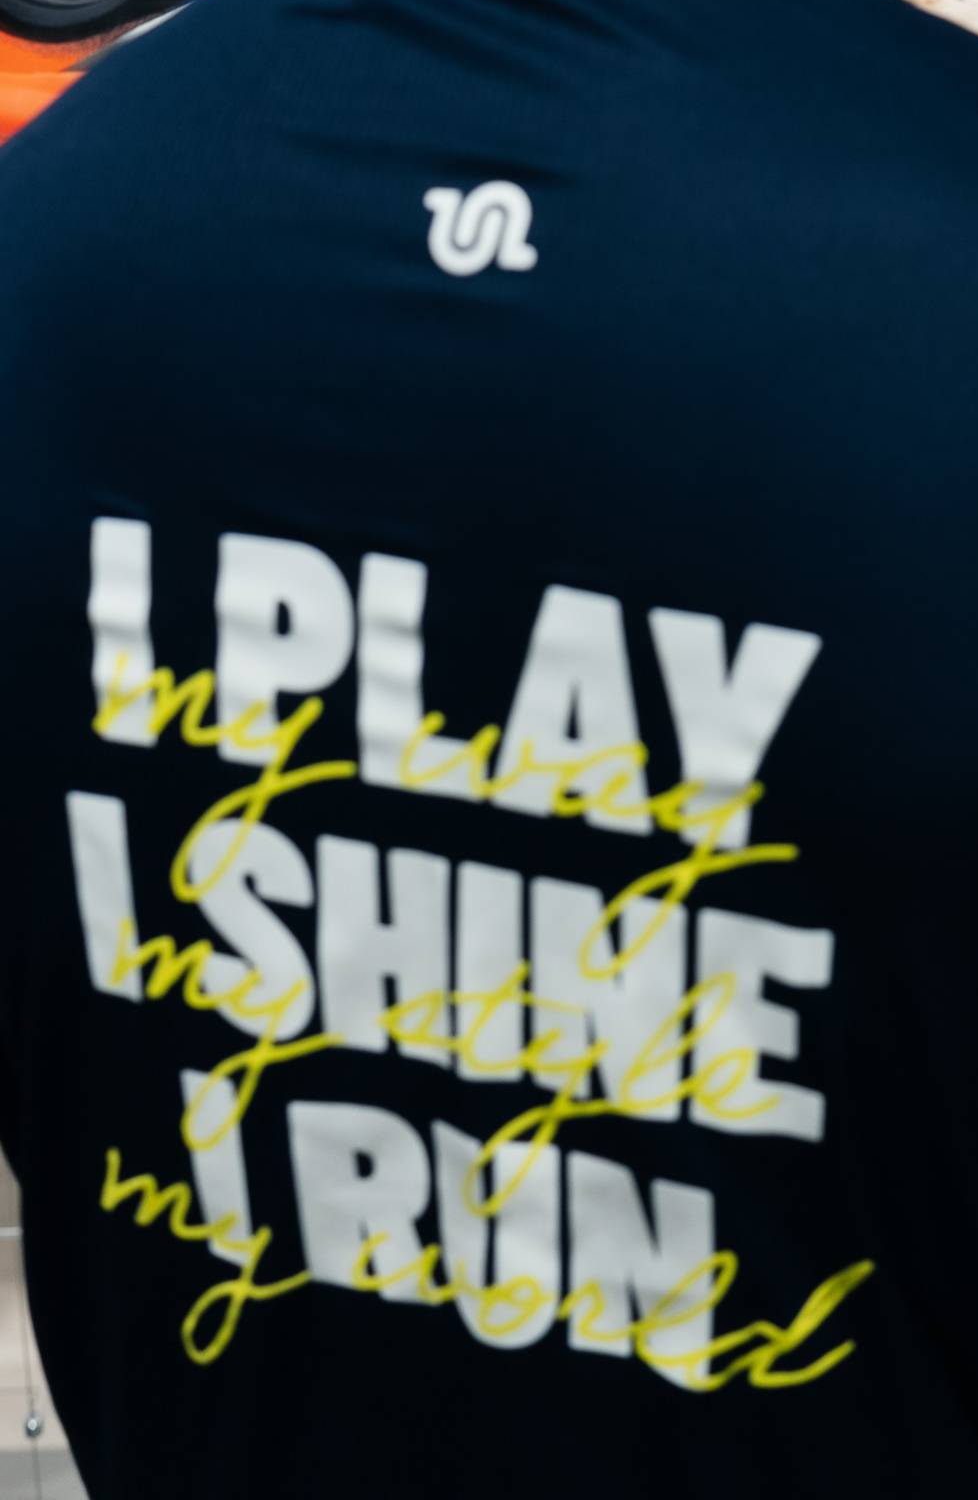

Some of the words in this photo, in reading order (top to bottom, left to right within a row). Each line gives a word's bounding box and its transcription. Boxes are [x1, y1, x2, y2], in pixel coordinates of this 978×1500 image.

[88, 516, 156, 748] I
[214, 531, 823, 849] PLAY
[93, 650, 358, 902] my
[403, 712, 799, 979] way
[67, 790, 142, 1001] I
[190, 818, 835, 1142] SHINE
[111, 920, 346, 1150] my
[379, 962, 782, 1216] style
[102, 1148, 311, 1365] my
[353, 1232, 877, 1391] world
[182, 1069, 252, 1266] I
[288, 1100, 715, 1392] RUN
